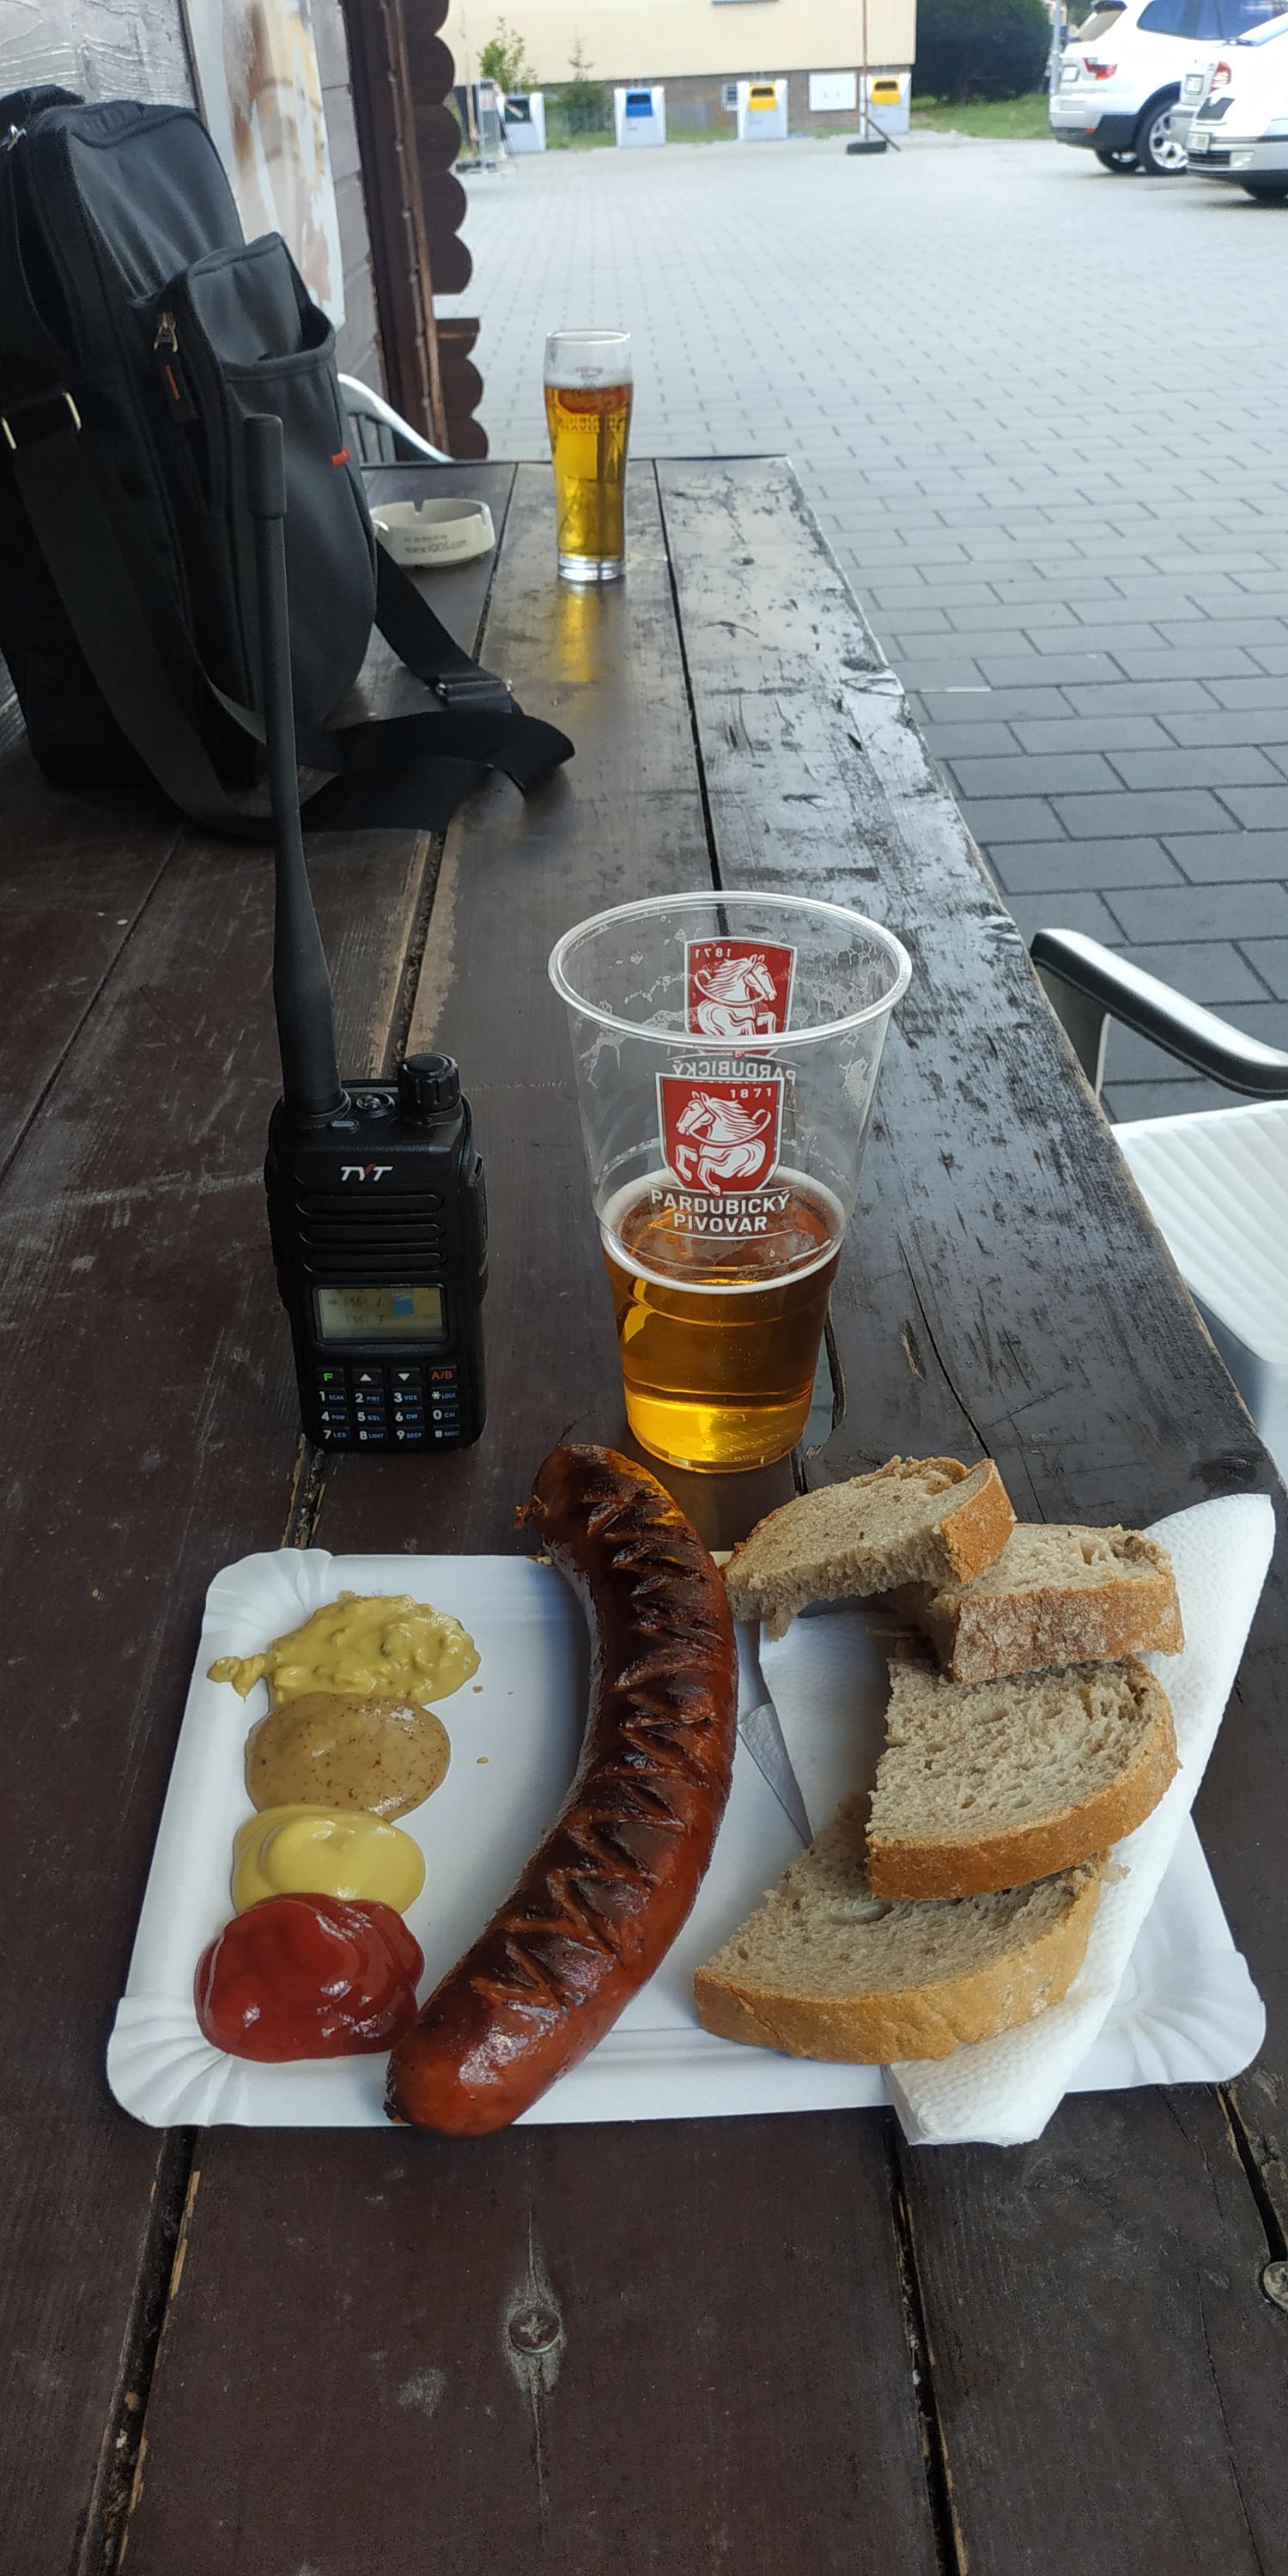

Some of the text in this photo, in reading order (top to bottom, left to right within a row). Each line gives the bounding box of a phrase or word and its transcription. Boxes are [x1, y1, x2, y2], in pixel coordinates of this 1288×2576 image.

[730, 1086, 772, 1099] 1871
[340, 1163, 394, 1182] TYT
[651, 1189, 791, 1216] PARDUBICKÝ
[673, 1212, 768, 1233] PIVOVAR
[324, 1373, 333, 1382] F
[432, 1370, 453, 1380] A/B
[319, 1391, 325, 1401] 1
[355, 1393, 364, 1403] 2
[394, 1392, 403, 1403] 3
[321, 1411, 330, 1421] 4
[357, 1411, 366, 1422] 5
[395, 1411, 404, 1422] 6
[433, 1409, 442, 1420] 0
[323, 1430, 331, 1440] 7
[359, 1431, 368, 1441] 8
[397, 1430, 405, 1441] 9
